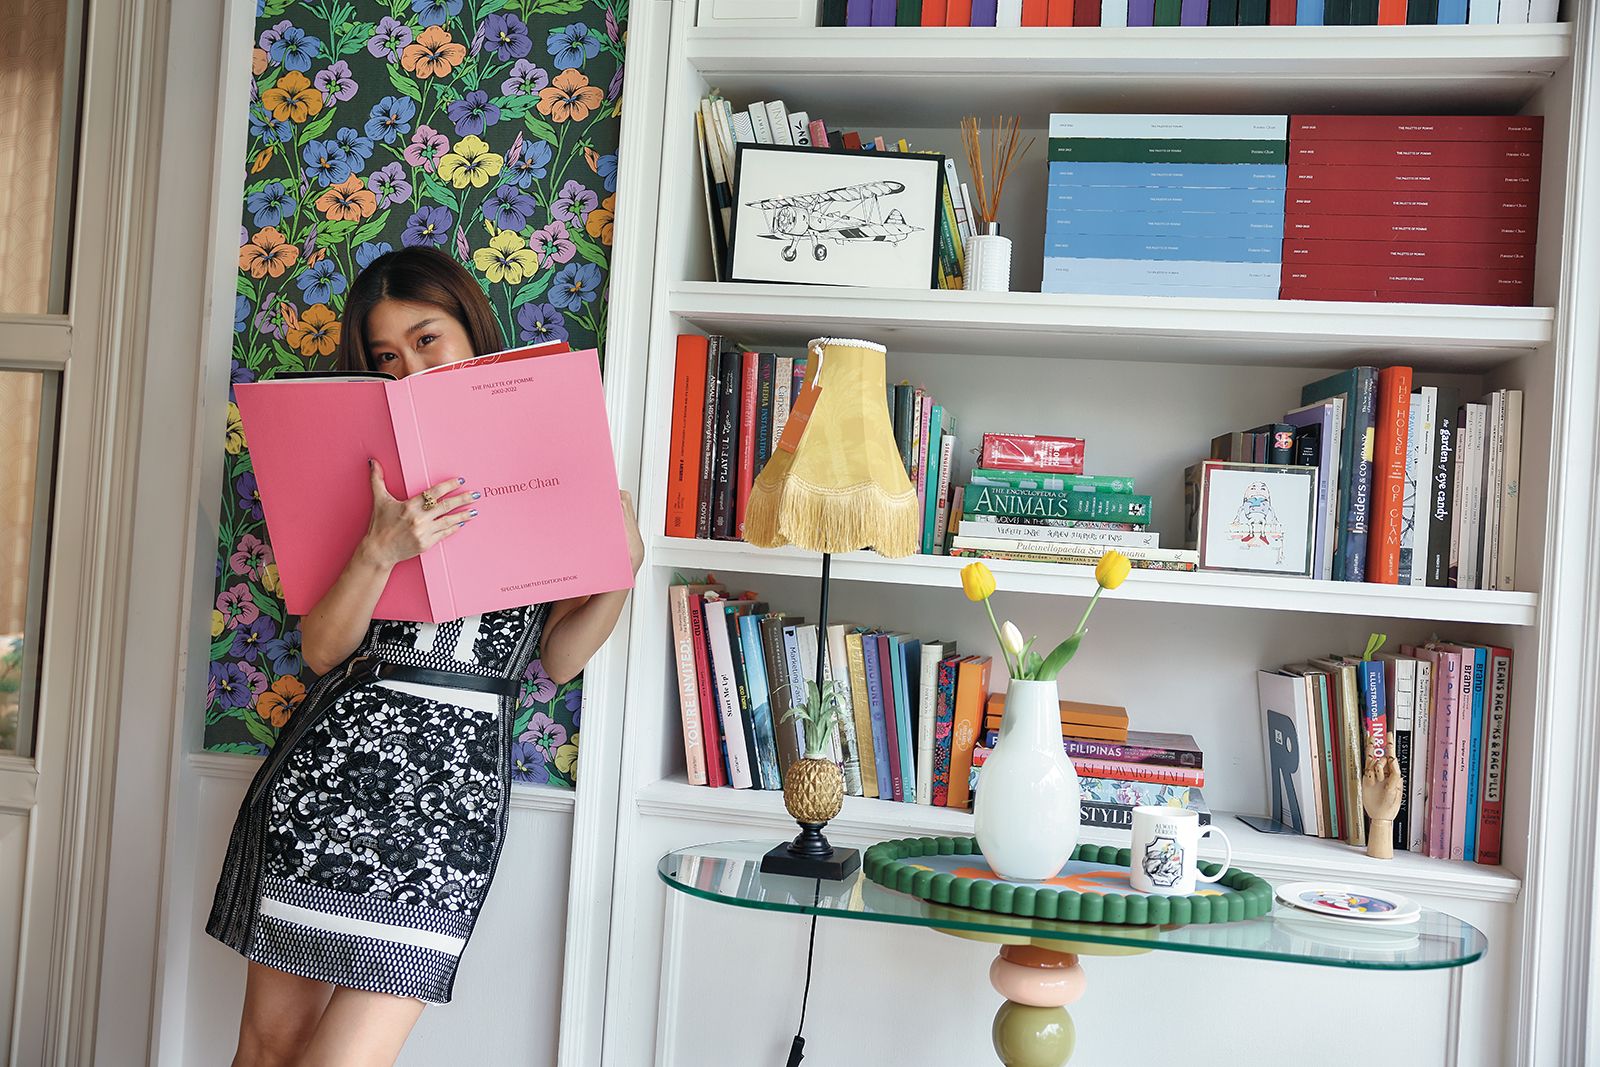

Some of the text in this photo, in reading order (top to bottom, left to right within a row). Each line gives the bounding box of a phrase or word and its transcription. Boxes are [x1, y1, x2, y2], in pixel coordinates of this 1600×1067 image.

[514, 377, 534, 385] POMME
[762, 364, 770, 381] NEW
[491, 386, 517, 395] 2002-2022
[1399, 376, 1407, 403] THE
[777, 386, 787, 418] Carpets
[759, 408, 768, 459] INSTALLATION
[1394, 410, 1406, 455] HOUSE
[1404, 411, 1415, 473] DRAWING NOW
[921, 447, 926, 456] AT
[1439, 428, 1452, 462] garden
[721, 438, 729, 483] PLAYFUL
[484, 477, 560, 497] Pomme Chan
[1435, 472, 1447, 490] eye
[973, 487, 1068, 518] ANIMALS
[1006, 489, 1056, 497] ENCYCLOPEDIA
[1392, 485, 1400, 502] OF
[1352, 485, 1366, 534] Insiders
[1434, 491, 1448, 521] candy
[996, 516, 1020, 524] WOLVES
[1016, 542, 1086, 556] Pulcinellopaedia
[790, 646, 799, 683] Marketing
[1497, 661, 1506, 690] DEAN'S
[680, 637, 699, 749] YOU'RE INVITED!
[724, 688, 729, 698] Me
[1494, 693, 1504, 712] RAG
[1492, 714, 1502, 740] BOOKS
[1070, 744, 1122, 757] FILIPINAS
[1490, 749, 1500, 770] RAG
[1489, 772, 1498, 799] DOLLS
[1080, 806, 1133, 824] STYLE
